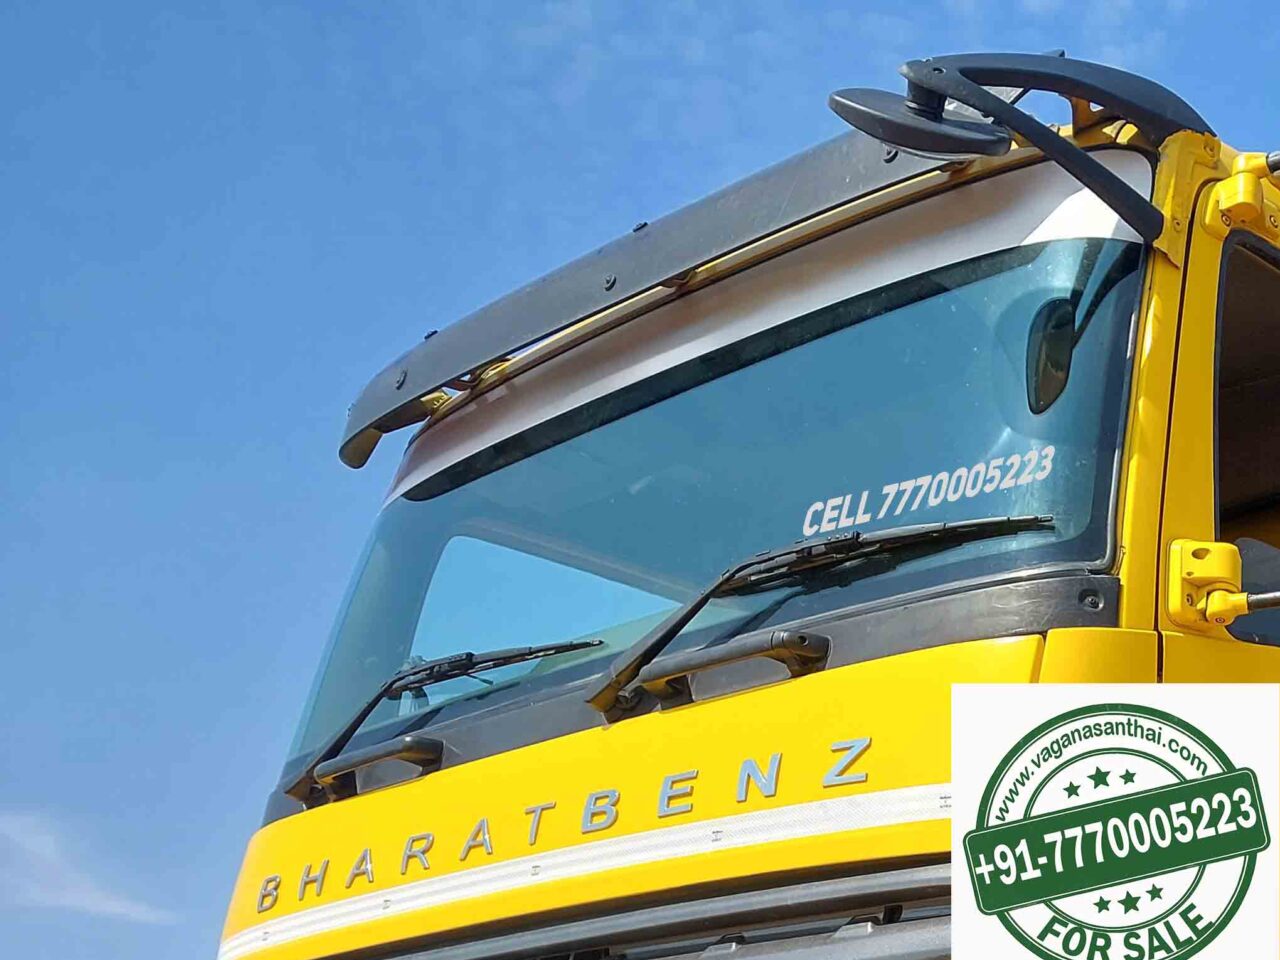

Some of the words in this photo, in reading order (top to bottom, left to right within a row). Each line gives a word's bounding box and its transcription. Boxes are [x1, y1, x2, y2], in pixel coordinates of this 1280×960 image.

[802, 490, 871, 537] CELL
[876, 445, 1056, 520] 7770005223
[256, 736, 873, 914] BHARATBENZ
